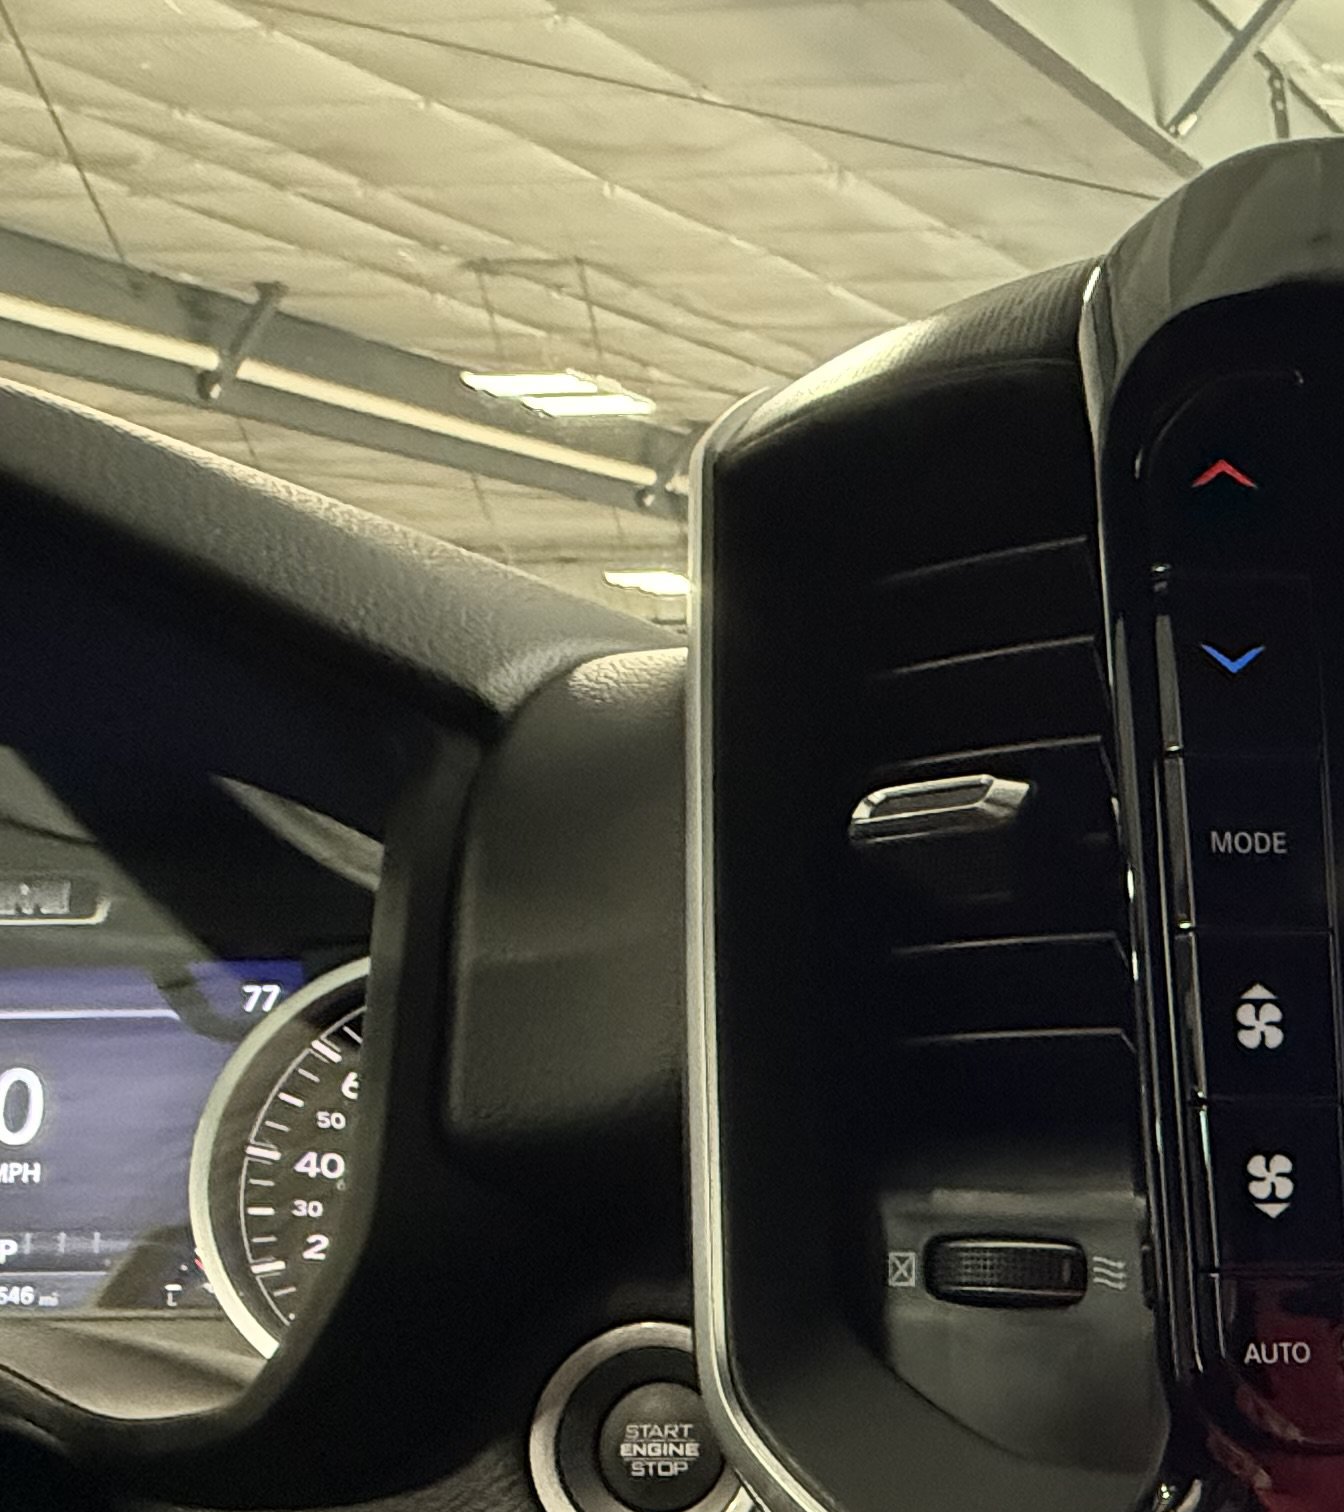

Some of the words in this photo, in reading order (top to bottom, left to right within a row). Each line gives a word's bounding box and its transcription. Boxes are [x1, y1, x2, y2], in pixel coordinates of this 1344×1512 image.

[1210, 830, 1288, 854] MODE
[242, 983, 281, 1013] 77
[0, 1067, 44, 1146] 0
[316, 1110, 347, 1130] 50
[293, 1151, 346, 1180] 40
[291, 1200, 324, 1218] 30
[1243, 1340, 1312, 1365] AUTO
[625, 1423, 694, 1439] START
[620, 1442, 701, 1457] ENGINE
[630, 1460, 690, 1477] STOP
